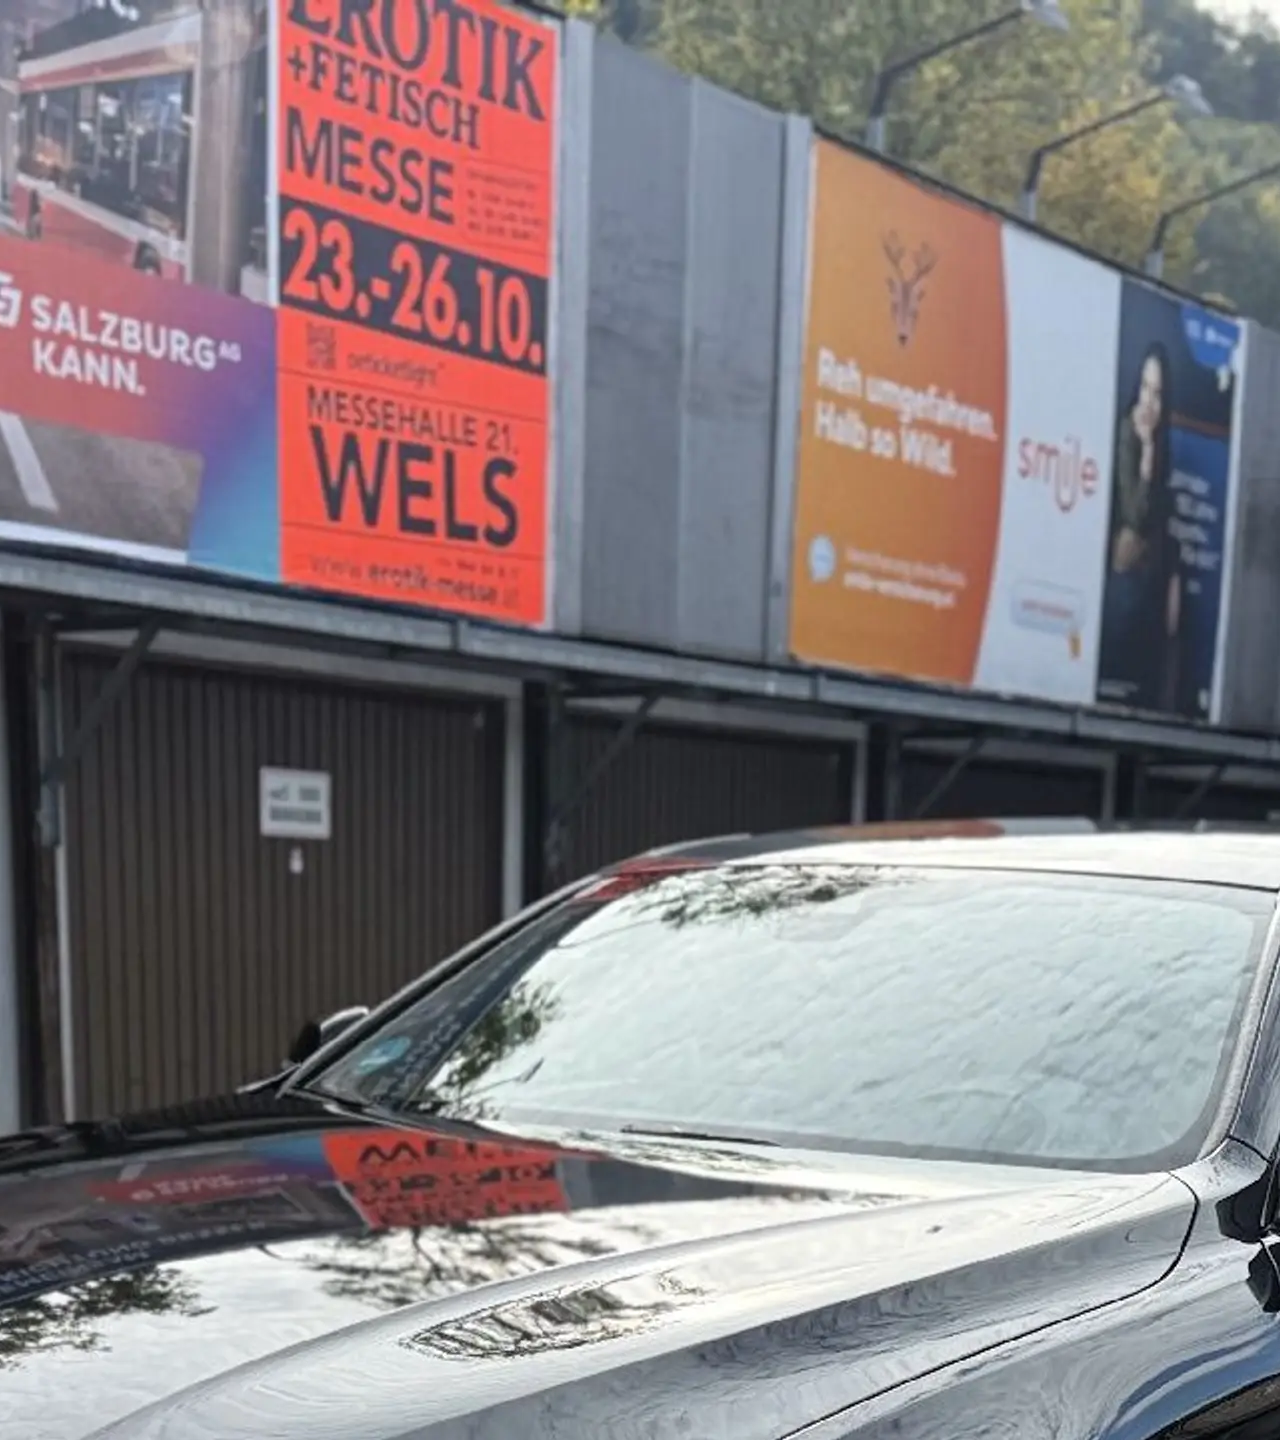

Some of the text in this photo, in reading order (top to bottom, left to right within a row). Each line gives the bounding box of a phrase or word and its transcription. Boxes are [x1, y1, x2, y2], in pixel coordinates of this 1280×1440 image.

[287, 40, 481, 151] +FETISCH
[286, 104, 455, 226] MESSE
[282, 208, 543, 366] 23.-26.10.
[30, 294, 217, 371] SALZBURG
[32, 337, 147, 396] KANN.
[817, 345, 863, 398] Reh
[307, 384, 519, 456] MESSEHALLE 21.
[815, 399, 957, 477] Halb so Wild.
[309, 423, 520, 548] WELS
[1017, 434, 1100, 513] smile
